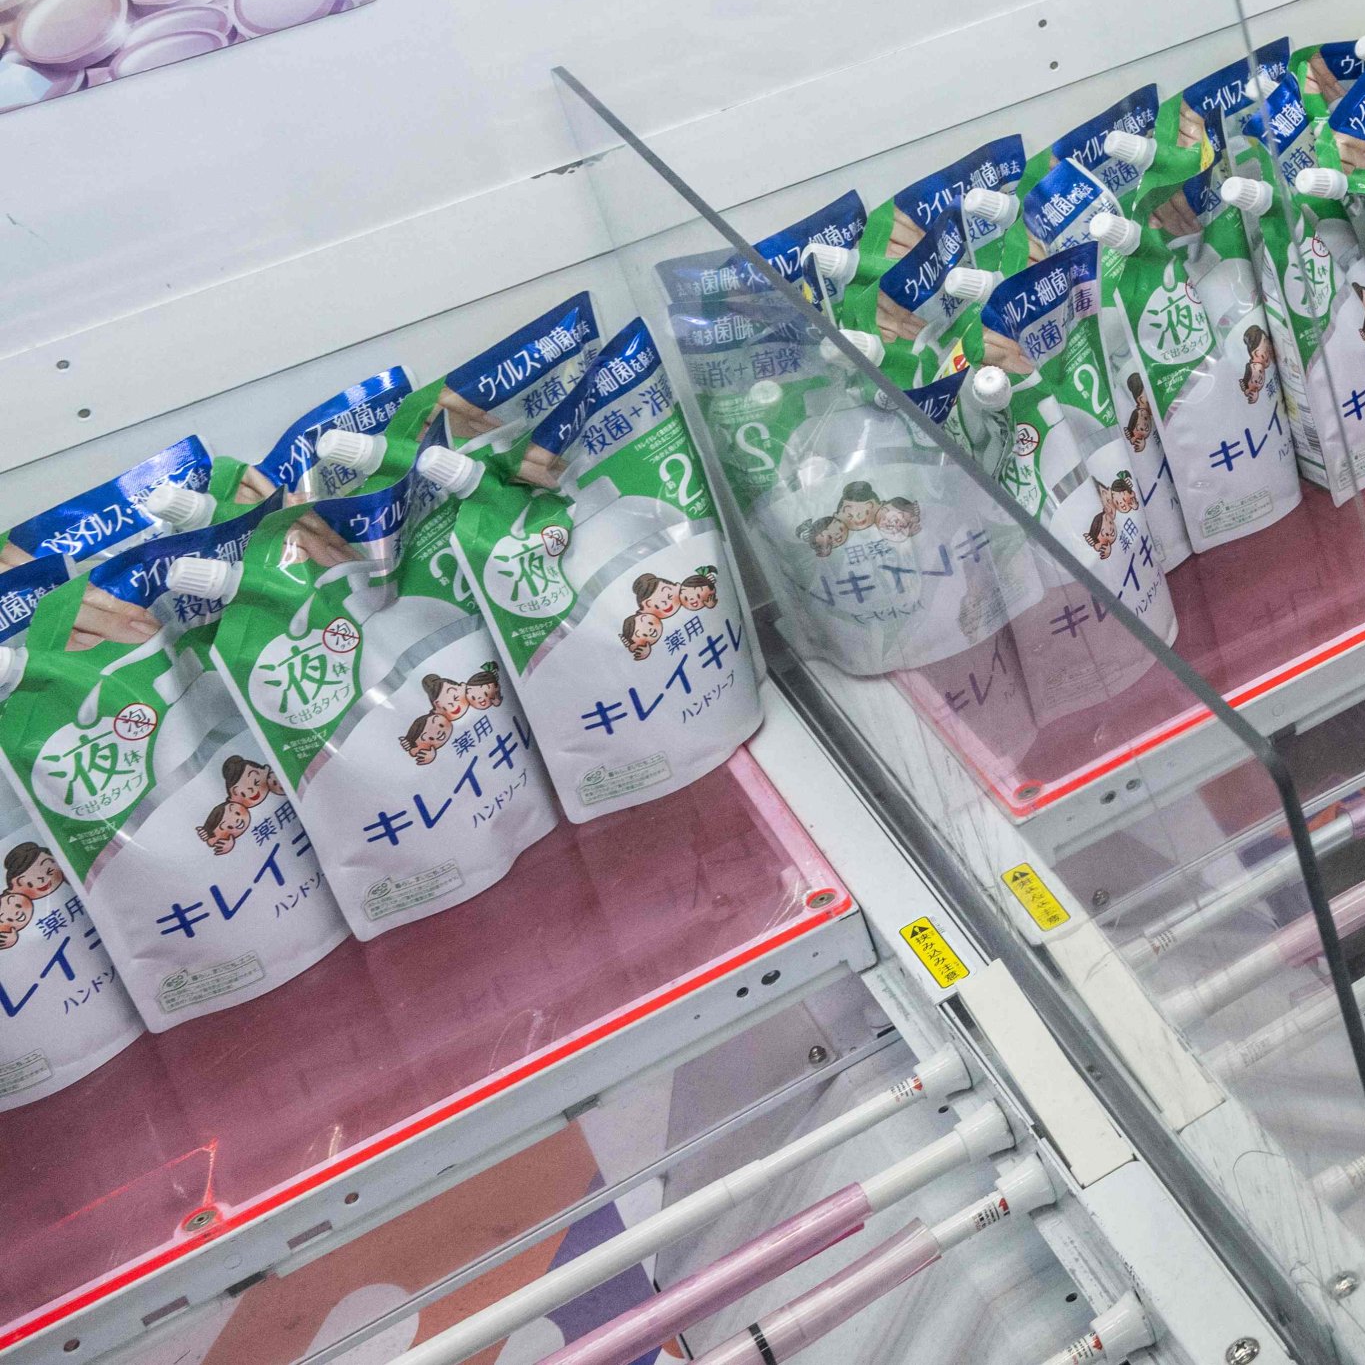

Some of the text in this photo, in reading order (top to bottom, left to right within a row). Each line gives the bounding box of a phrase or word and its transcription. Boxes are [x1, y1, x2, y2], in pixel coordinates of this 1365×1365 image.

[664, 615, 704, 655] 薬用
[259, 641, 351, 713] 液体
[681, 670, 736, 724] ハンドソープ
[285, 685, 351, 726] で出るタイプ
[452, 715, 494, 758] 薬用
[42, 730, 144, 805] 液体
[70, 774, 144, 816] で出るタイプ
[471, 768, 529, 829] ハンドソープ
